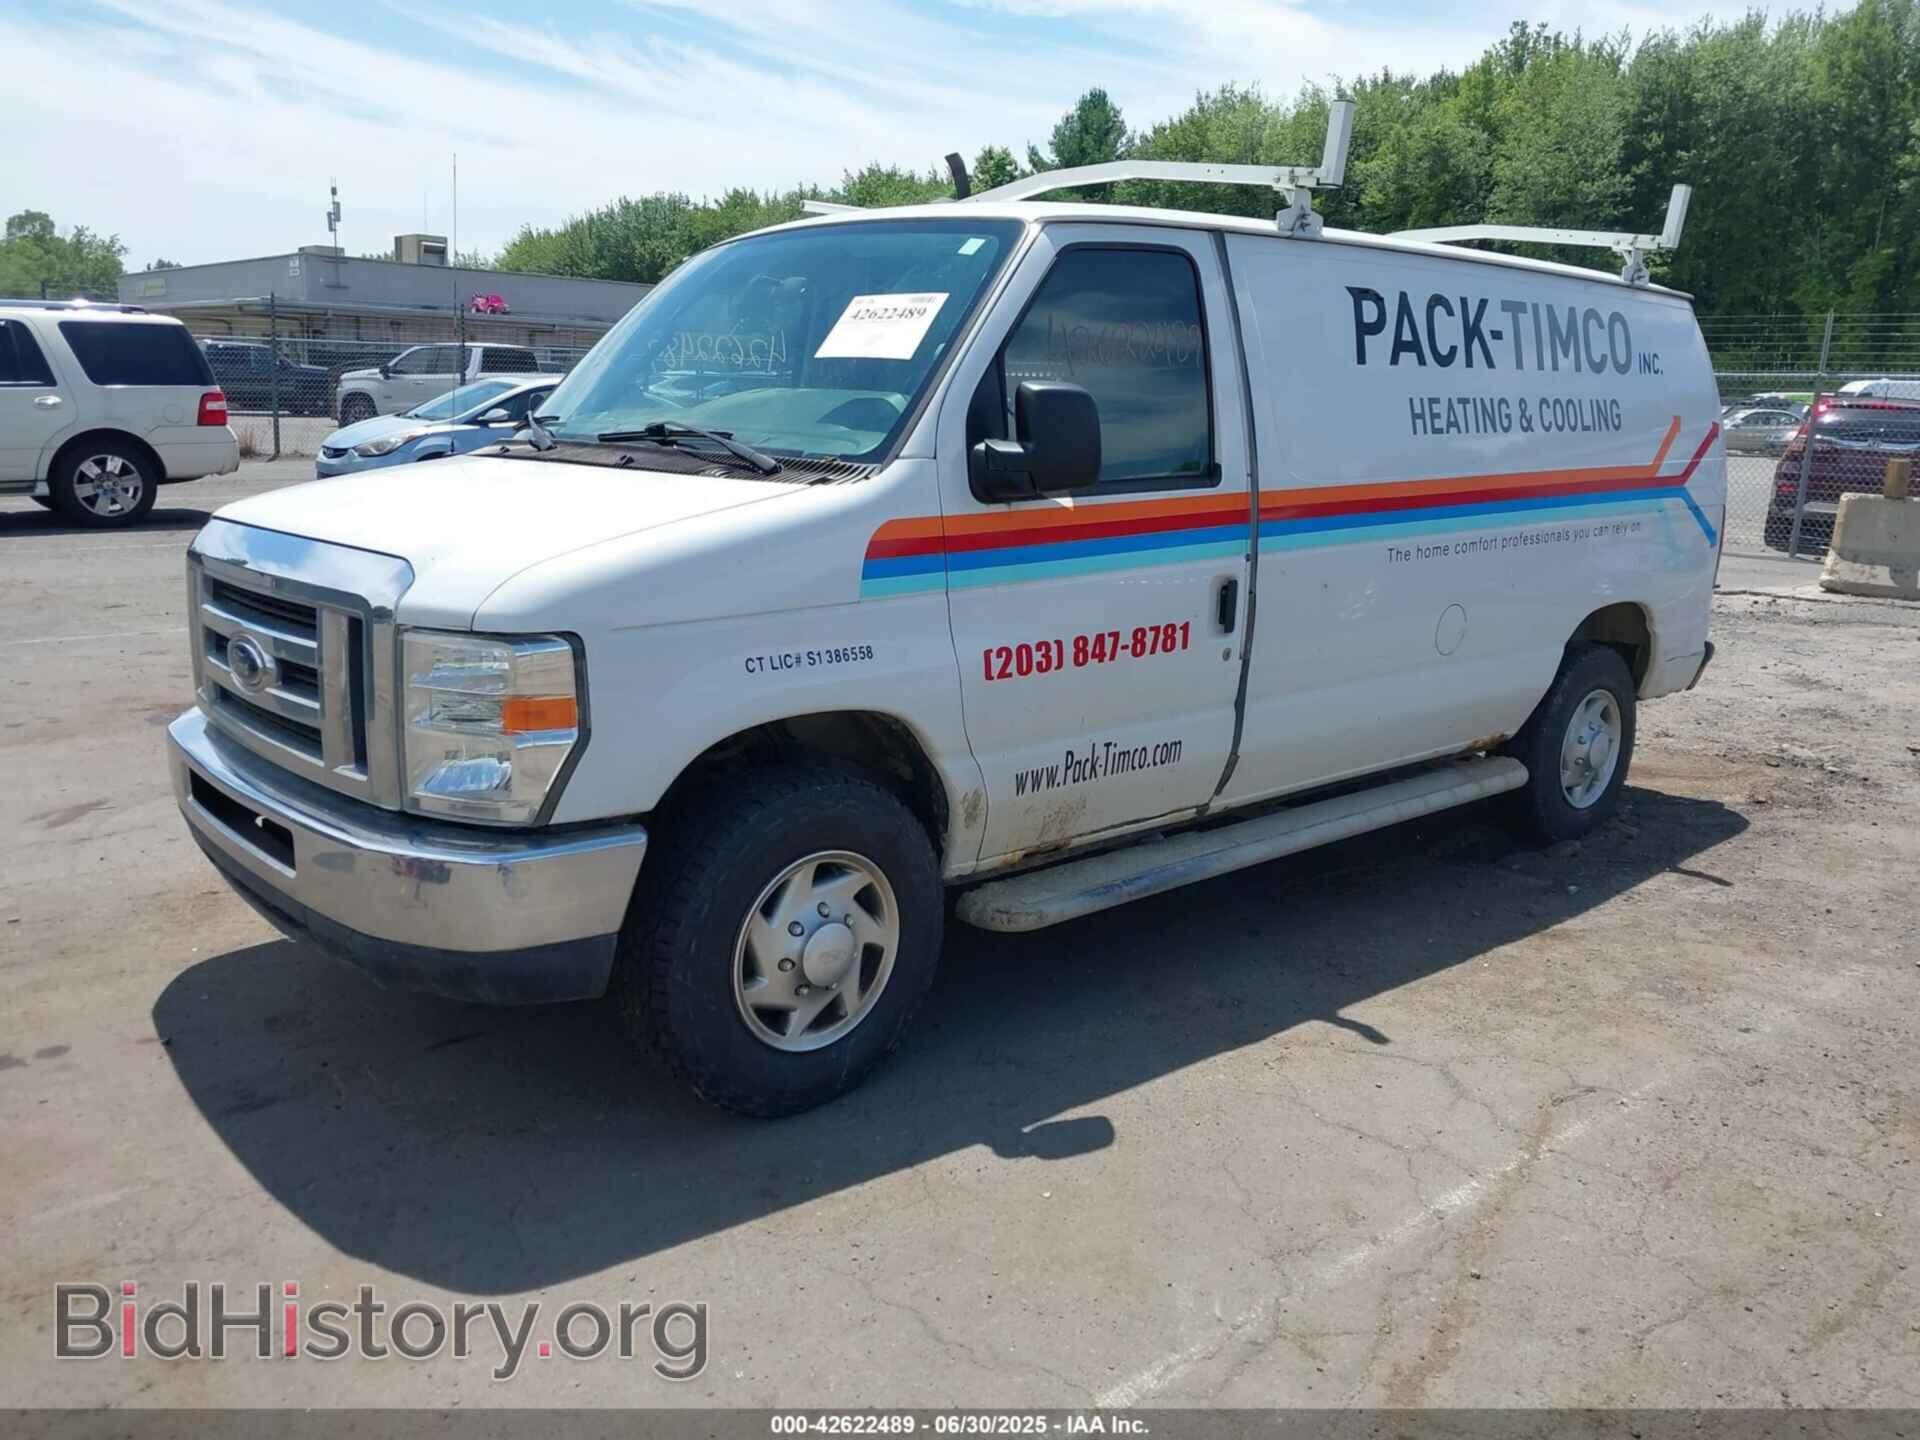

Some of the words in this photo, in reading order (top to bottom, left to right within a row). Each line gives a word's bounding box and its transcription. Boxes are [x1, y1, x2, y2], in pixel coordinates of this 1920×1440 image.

[850, 307, 928, 320] 42622489
[1345, 286, 1633, 375] PACK-TIMCO
[1638, 352, 1664, 375] INC.
[1409, 397, 1512, 435] HEATING
[1518, 398, 1535, 433] &
[1538, 398, 1622, 432] COOLING
[1387, 547, 1411, 562] The
[1416, 544, 1450, 560] home
[1454, 536, 1498, 555] comfort
[1501, 530, 1571, 551] professionals
[1574, 529, 1590, 543] you
[1593, 524, 1609, 537] can
[1612, 520, 1628, 537] rely
[745, 656, 764, 673] CT
[769, 653, 802, 671] LIC#
[806, 645, 873, 666] S1386558
[983, 639, 1064, 681] (203)
[1072, 621, 1190, 667] 847-8781
[1015, 739, 1183, 797] www.Pack-Timco.com
